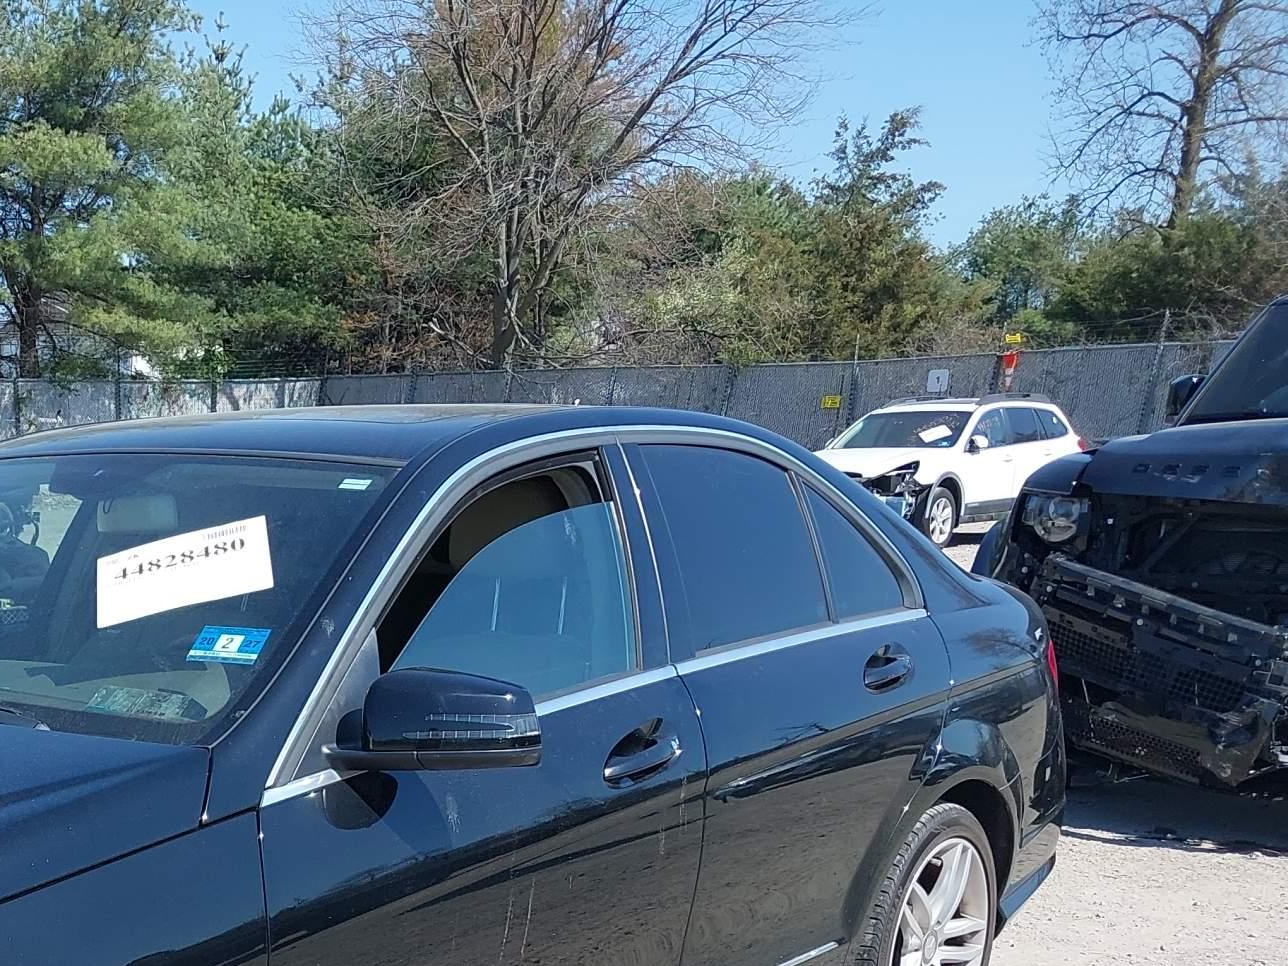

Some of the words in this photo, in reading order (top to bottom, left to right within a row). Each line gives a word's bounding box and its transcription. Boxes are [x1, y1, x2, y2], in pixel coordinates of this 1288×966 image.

[114, 538, 245, 579] 44828480
[198, 636, 215, 646] 20
[221, 637, 234, 649] 2
[242, 640, 261, 649] 27
